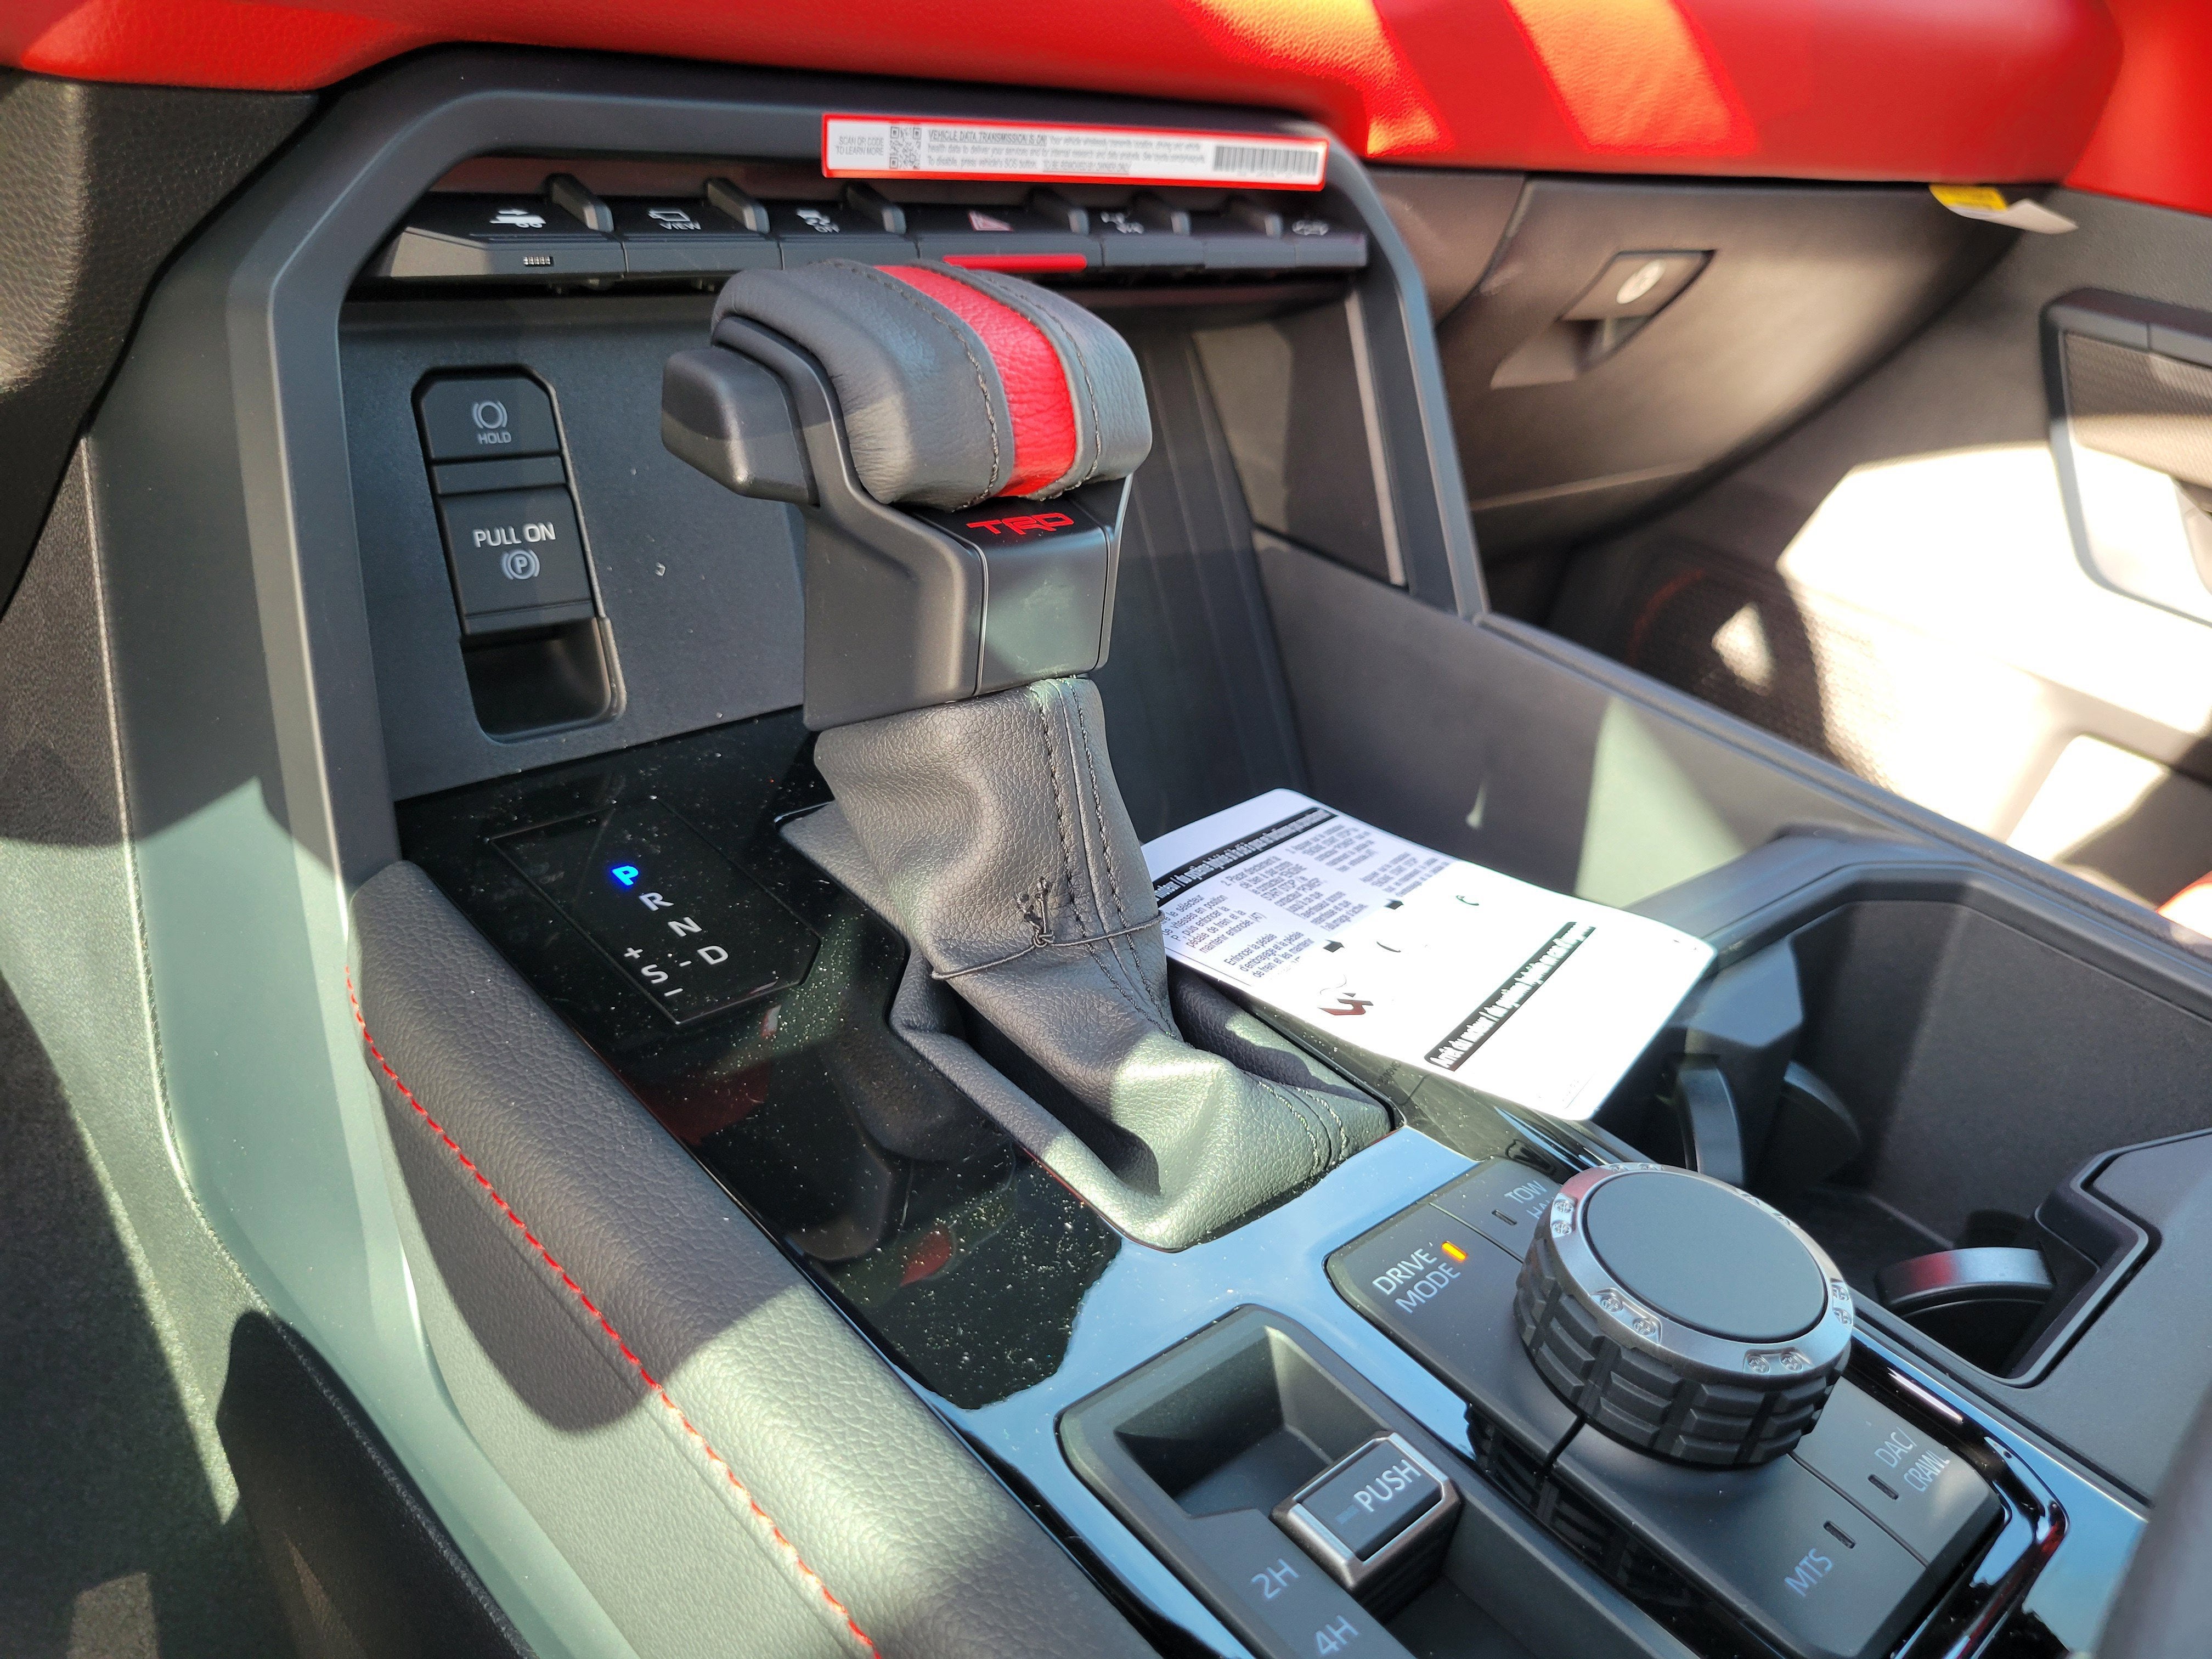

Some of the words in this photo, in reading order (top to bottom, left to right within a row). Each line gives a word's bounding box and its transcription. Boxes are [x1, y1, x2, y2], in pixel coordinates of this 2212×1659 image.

[929, 130, 957, 141] VEHICLE
[960, 131, 977, 141] DATA
[659, 222, 701, 230] VIEW
[478, 432, 511, 445] HOLD
[473, 527, 522, 548] PULL
[523, 522, 556, 542] ON
[966, 512, 1074, 535] TRD
[613, 866, 638, 886] P
[639, 892, 674, 911] R
[1170, 913, 1197, 928] vitesses
[1204, 895, 1227, 910] position
[1176, 895, 1203, 912] sélecteur
[668, 917, 702, 936] N
[1182, 926, 1198, 936] puis
[1196, 910, 1221, 926] enfoncer
[1186, 933, 1209, 948] pédale
[1214, 918, 1232, 928] frein
[697, 946, 728, 964] D
[1200, 935, 1228, 953] maintenir
[1224, 948, 1253, 965] Enfoncer
[1256, 934, 1277, 947] pédale
[641, 964, 668, 984] S
[1259, 963, 1276, 972] frein
[1504, 1180, 1547, 1203] TOW
[1373, 1248, 1437, 1295] DRIVE
[1395, 1262, 1461, 1314] MODE
[1875, 1428, 1917, 1469] DAC/
[1903, 1449, 1950, 1492] CRAWL
[1353, 1459, 1421, 1513] PUSH
[1251, 1558, 1299, 1600] 2H
[1784, 1548, 1833, 1598] MTS
[1314, 1615, 1359, 1656] 4H
